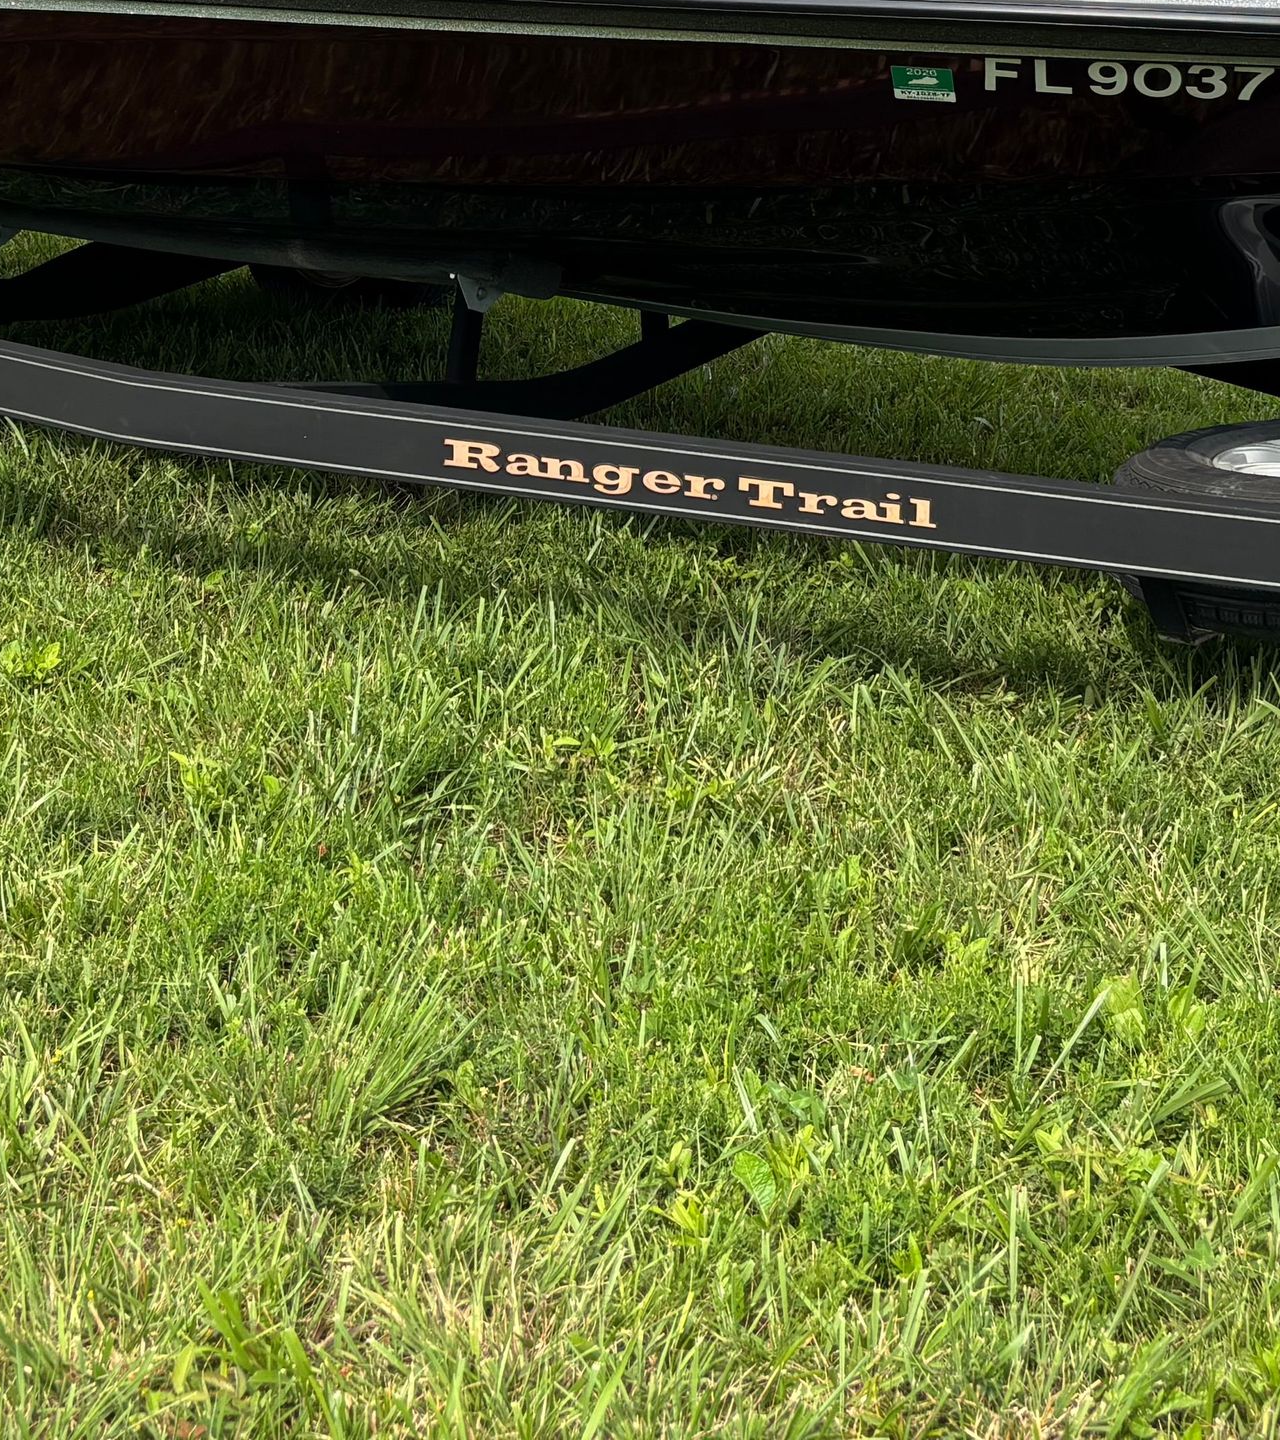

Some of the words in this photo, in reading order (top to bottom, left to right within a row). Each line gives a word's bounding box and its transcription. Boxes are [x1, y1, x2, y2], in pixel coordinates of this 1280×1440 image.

[984, 57, 1073, 95] FL
[1087, 61, 1275, 101] 9037
[443, 438, 724, 500] Ranger
[738, 476, 938, 529] Trail
